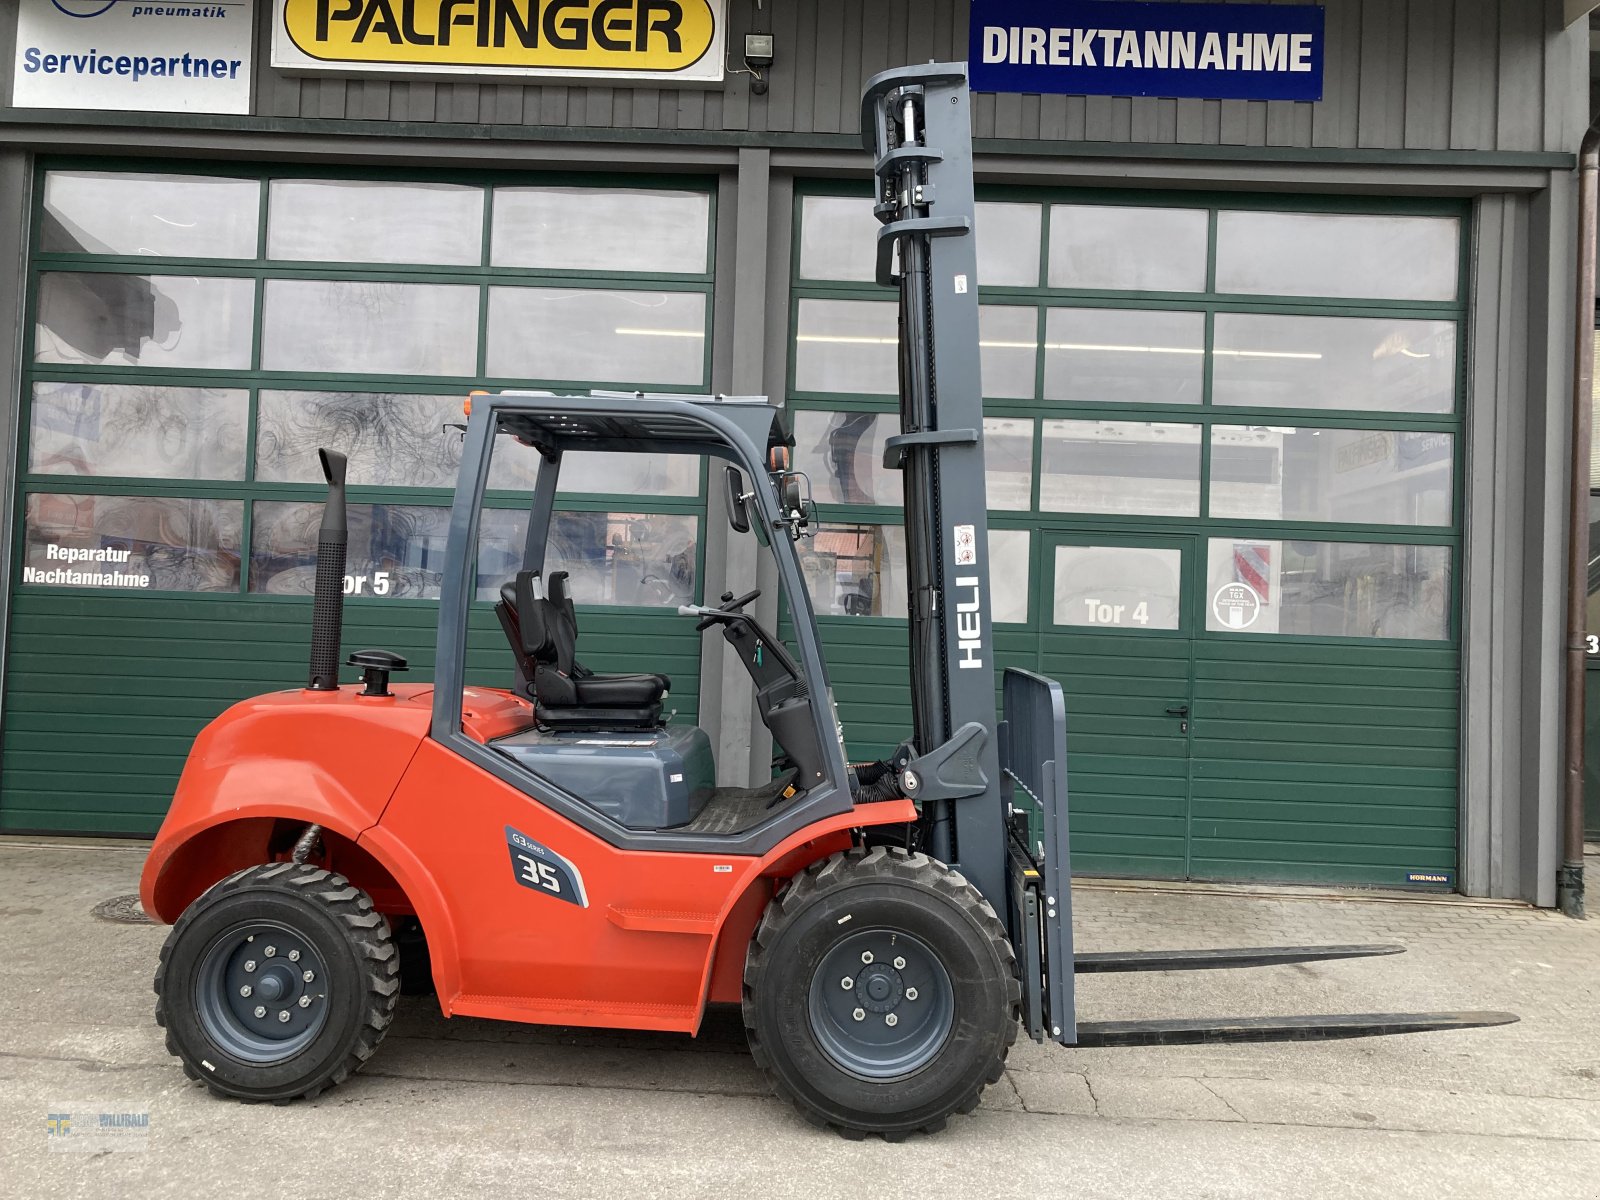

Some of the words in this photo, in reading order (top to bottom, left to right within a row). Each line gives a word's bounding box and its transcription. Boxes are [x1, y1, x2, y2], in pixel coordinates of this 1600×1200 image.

[132, 6, 226, 18] pneumatik
[315, 0, 683, 53] PALFINGER
[983, 27, 1313, 72] DIREKTANNAHME
[24, 47, 241, 82] Servicepartner
[46, 543, 131, 564] Reparatur
[23, 567, 150, 588] Nachtannahme
[341, 574, 367, 594] or
[373, 571, 390, 595] 5
[955, 576, 983, 669] HELI
[1084, 598, 1125, 624] Tor
[1132, 601, 1149, 625] 4
[1586, 634, 1600, 654] 3
[512, 833, 527, 847] G3
[527, 841, 545, 855] SERIES
[517, 854, 561, 893] 35
